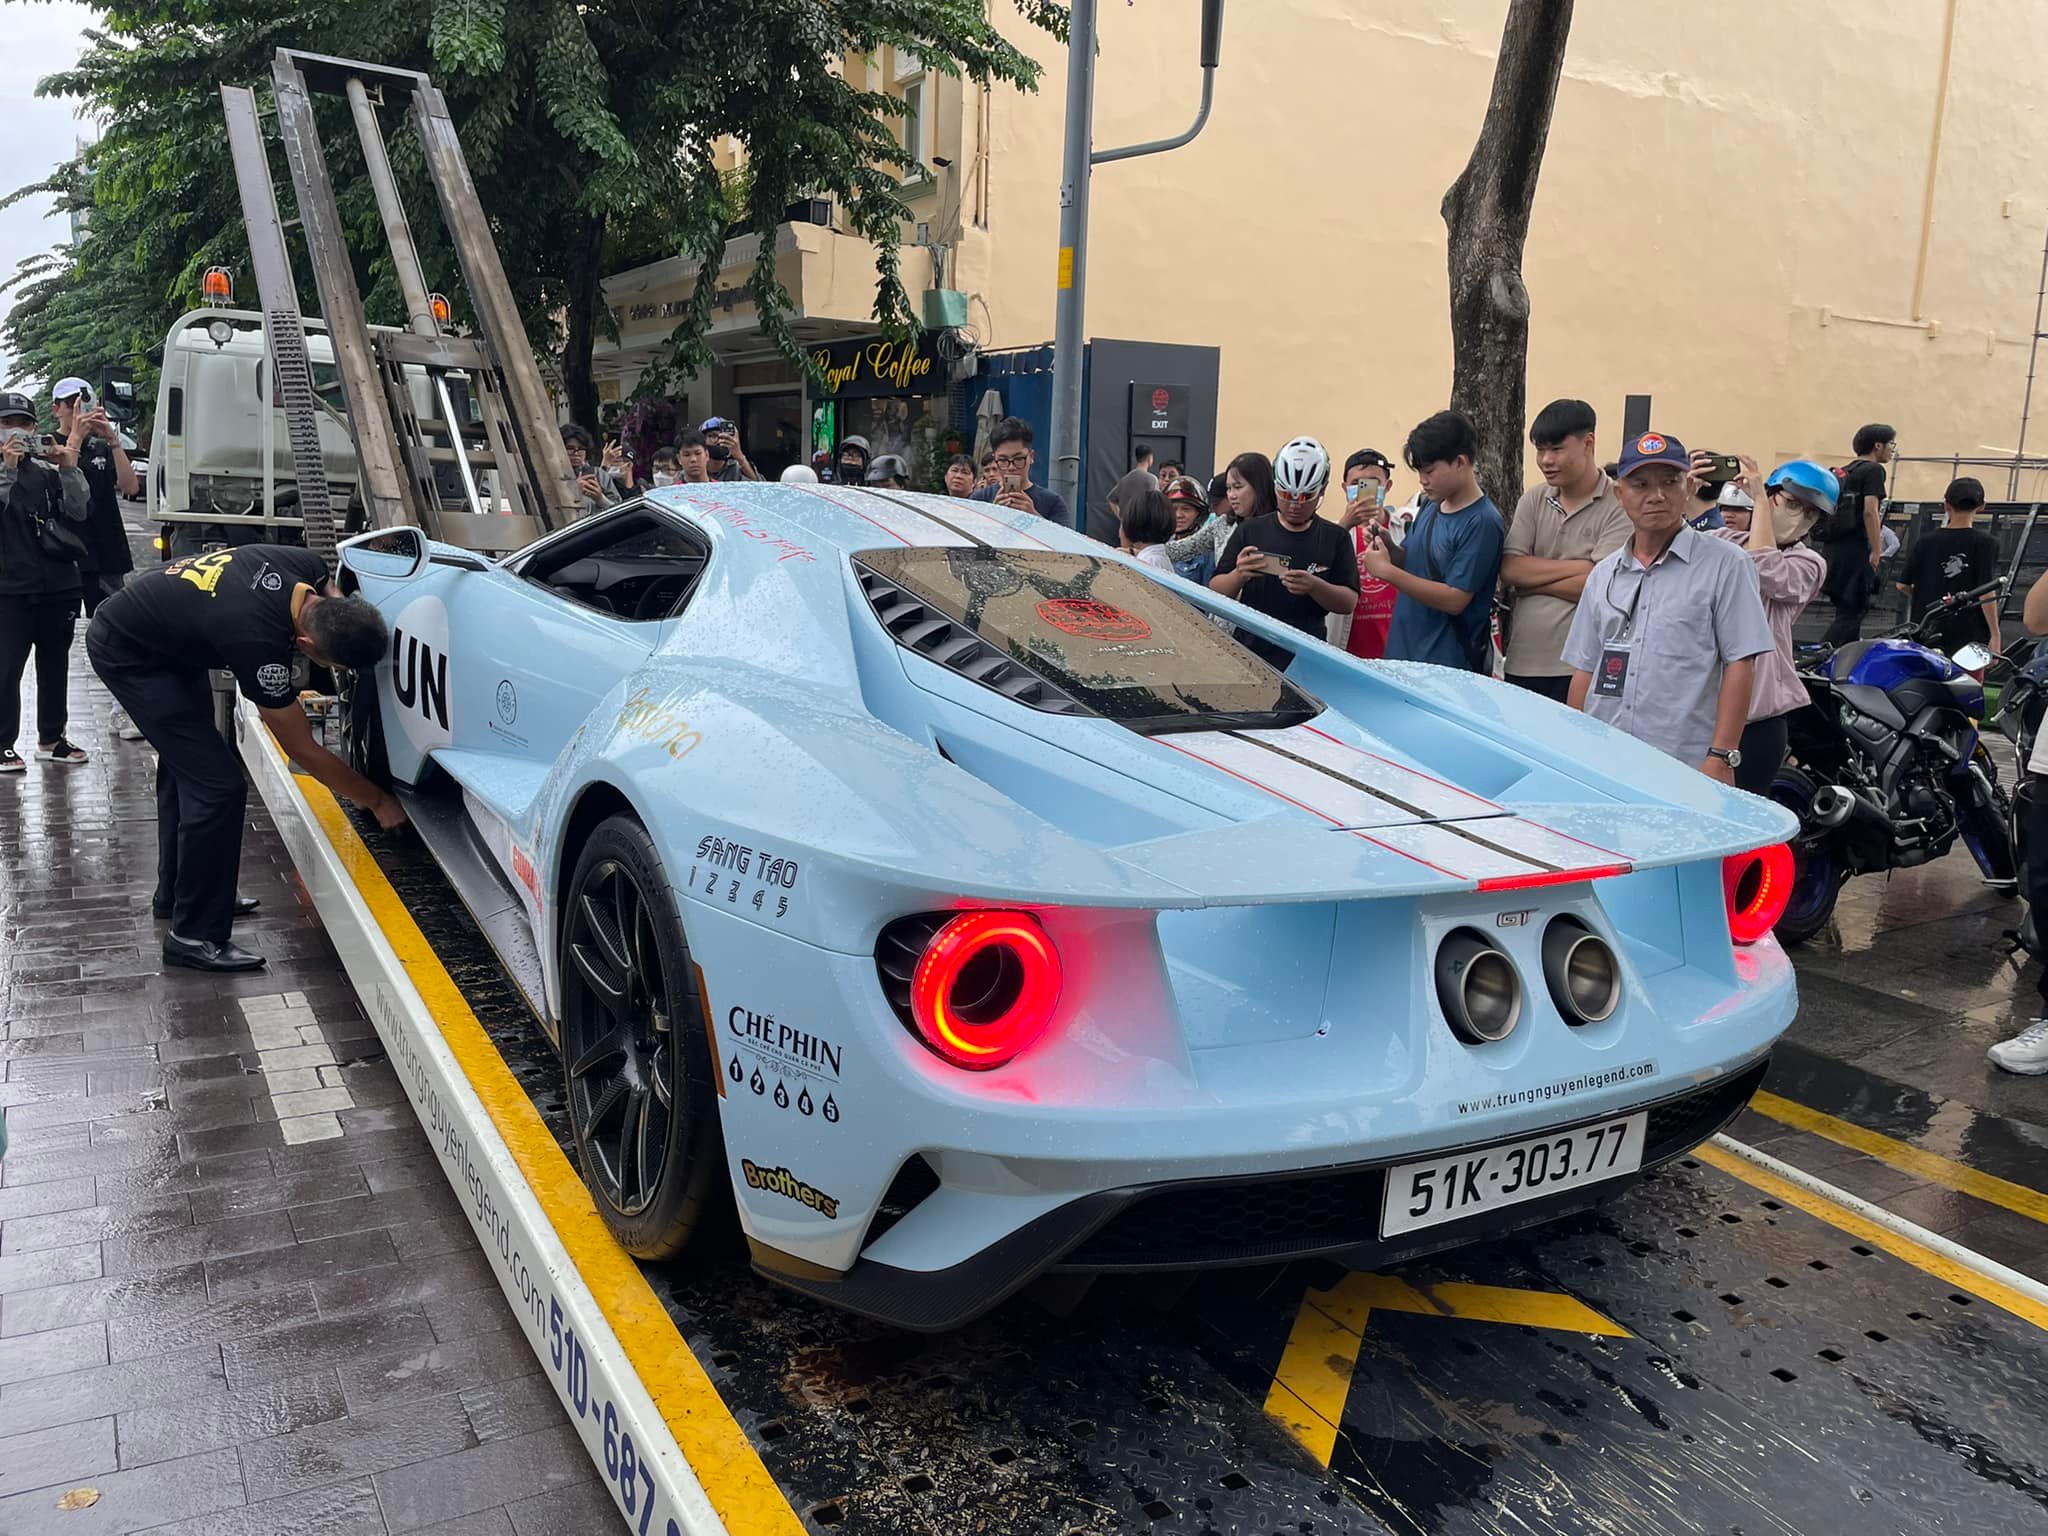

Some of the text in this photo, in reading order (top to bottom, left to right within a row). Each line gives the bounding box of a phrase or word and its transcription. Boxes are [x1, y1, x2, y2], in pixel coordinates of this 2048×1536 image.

[866, 342, 931, 388] Coffee
[1151, 420, 1169, 429] EXIT
[393, 627, 449, 732] UN
[689, 866, 789, 918] 1 2 3 4 5
[779, 1023, 842, 1078] PHIN
[1458, 1062, 1653, 1114] www.trungnguyenlegend.com
[375, 982, 546, 1338] www.trungnguyenlegend.com
[741, 1158, 838, 1220] Brothers
[1409, 1122, 1628, 1218] 51K-303.77
[550, 1293, 682, 1536] 51D-687
